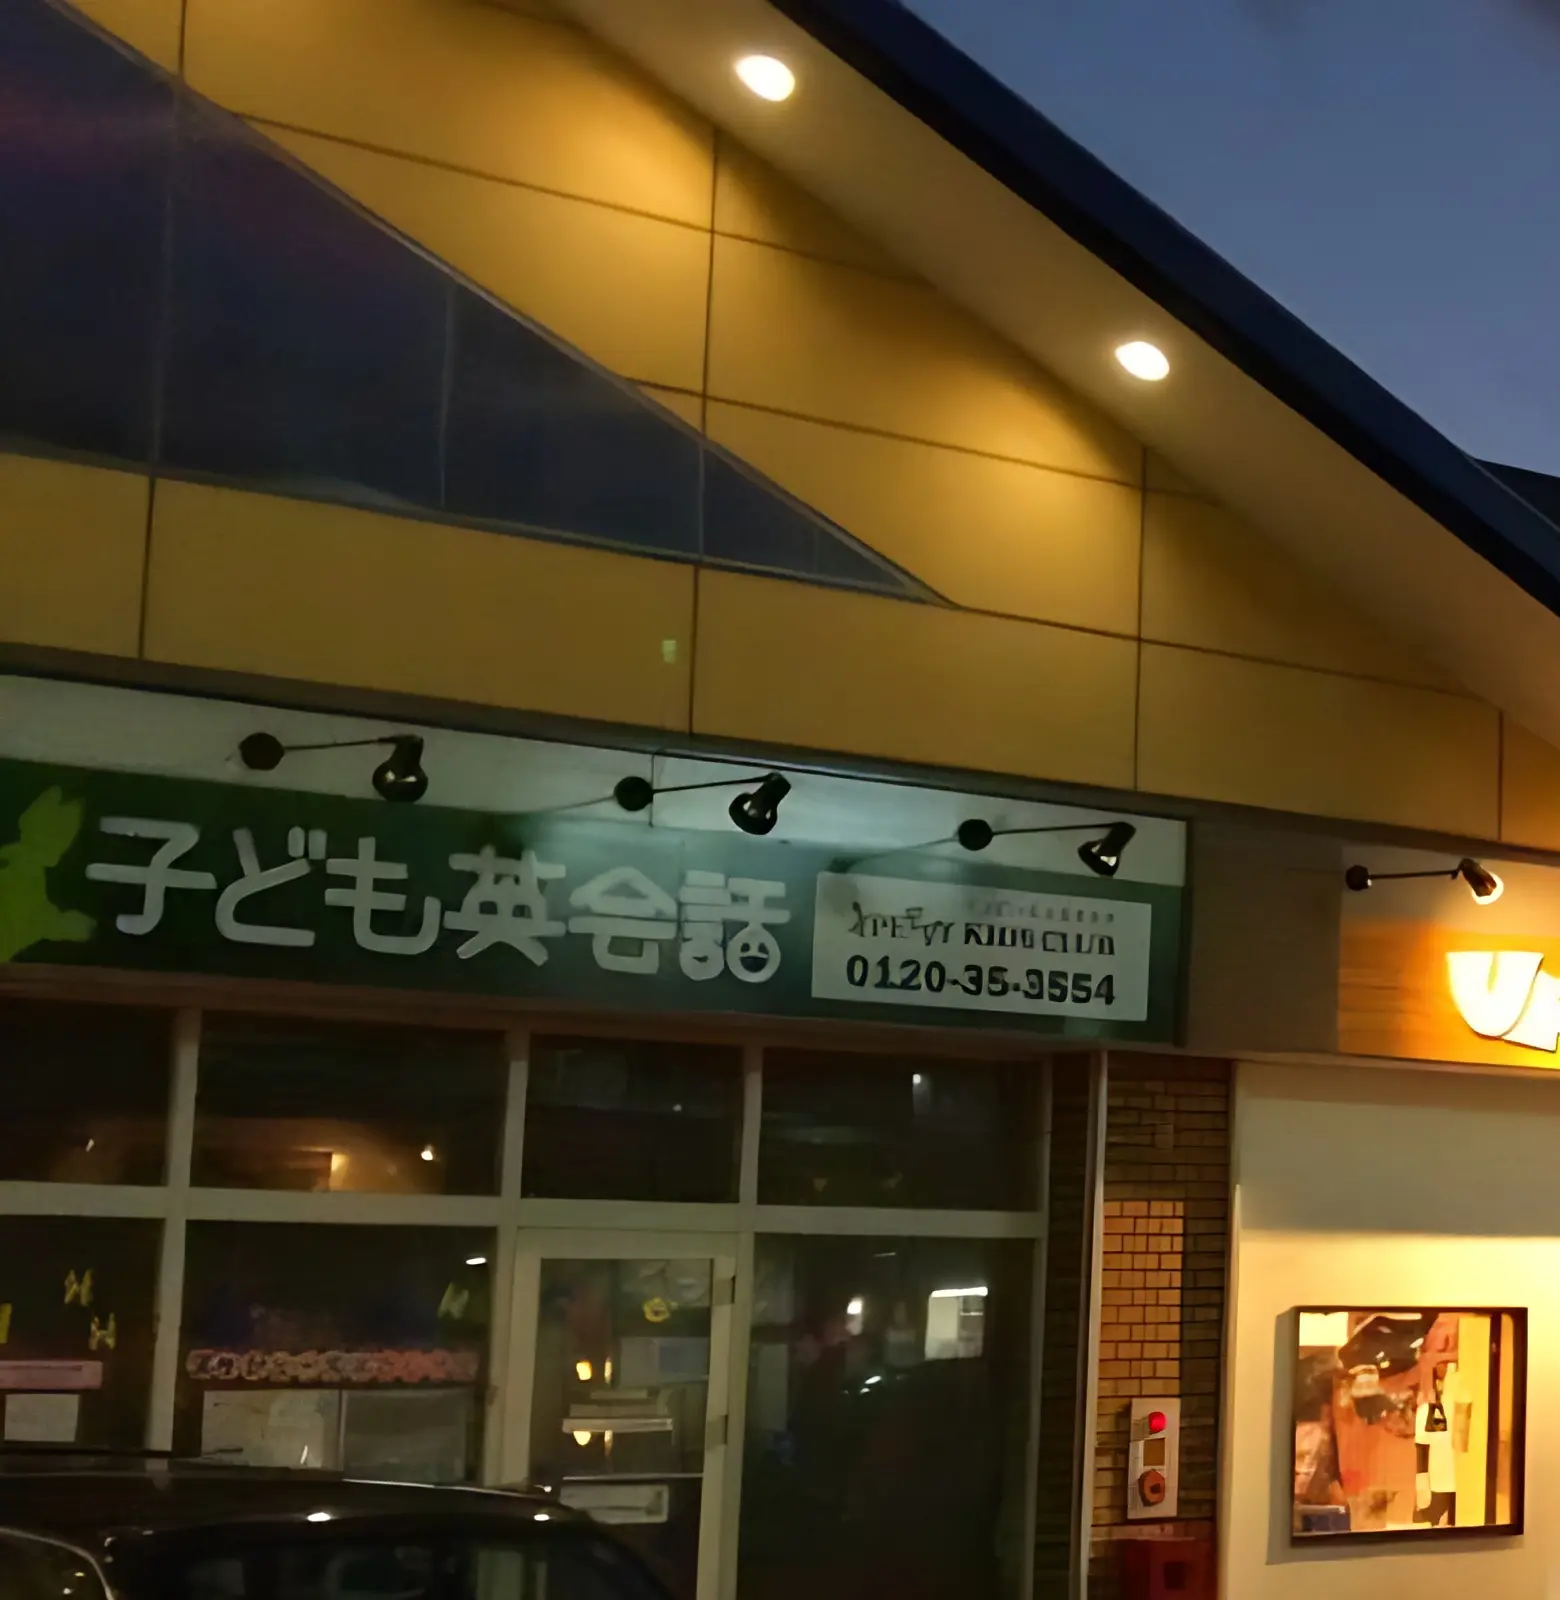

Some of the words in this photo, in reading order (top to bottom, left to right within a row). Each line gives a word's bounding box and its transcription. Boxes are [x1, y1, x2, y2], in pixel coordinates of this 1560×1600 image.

[86, 816, 790, 984] 子ども英会話
[846, 954, 1116, 1006] 0120-35-3554
